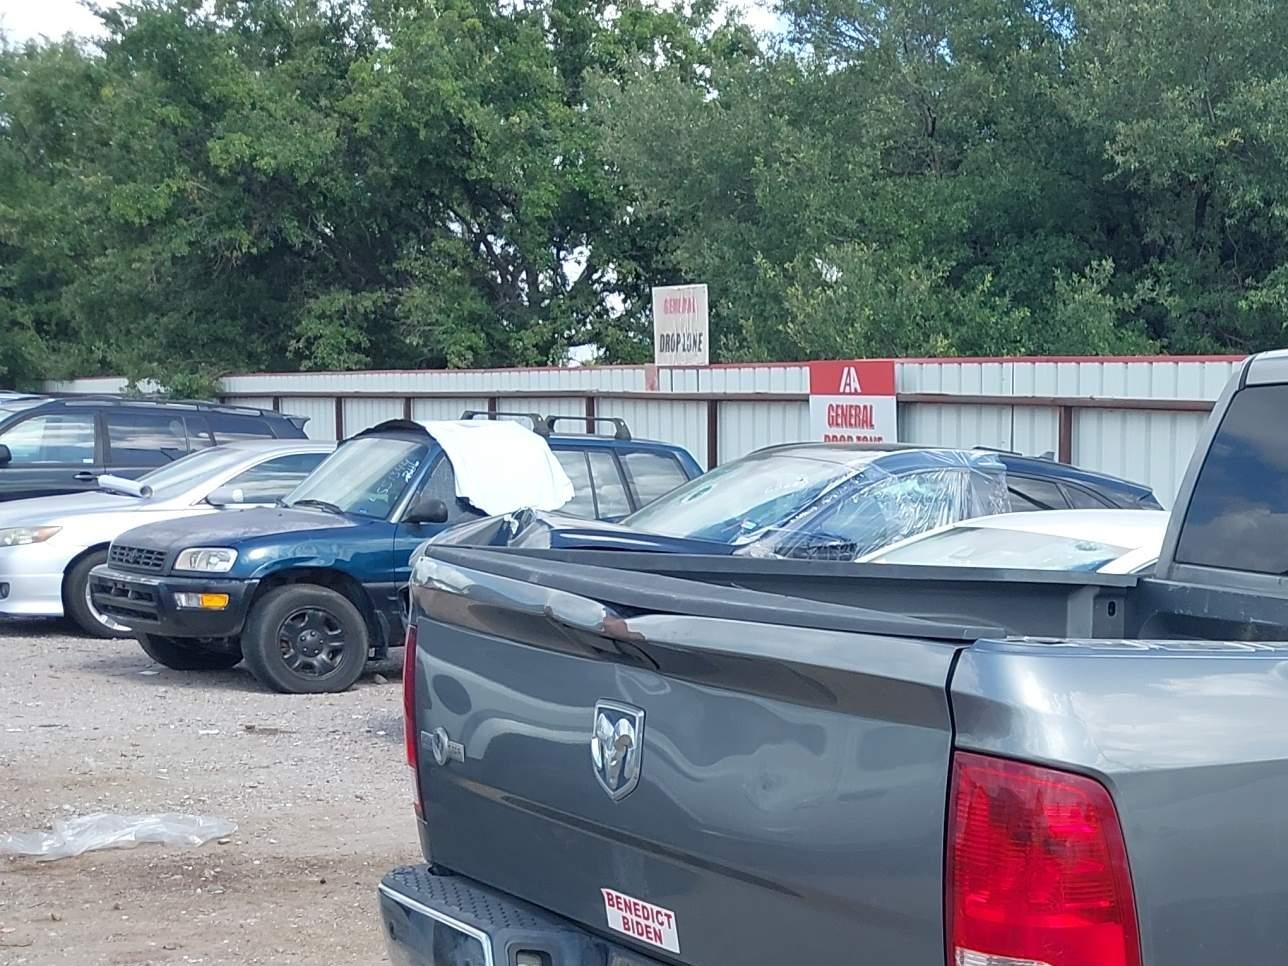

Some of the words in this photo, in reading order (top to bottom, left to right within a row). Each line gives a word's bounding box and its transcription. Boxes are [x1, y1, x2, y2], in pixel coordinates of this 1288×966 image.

[660, 333, 681, 353] DROP
[827, 403, 875, 430] GENERAL
[605, 890, 673, 930] BENEDICT
[621, 915, 664, 945] BIDEN
